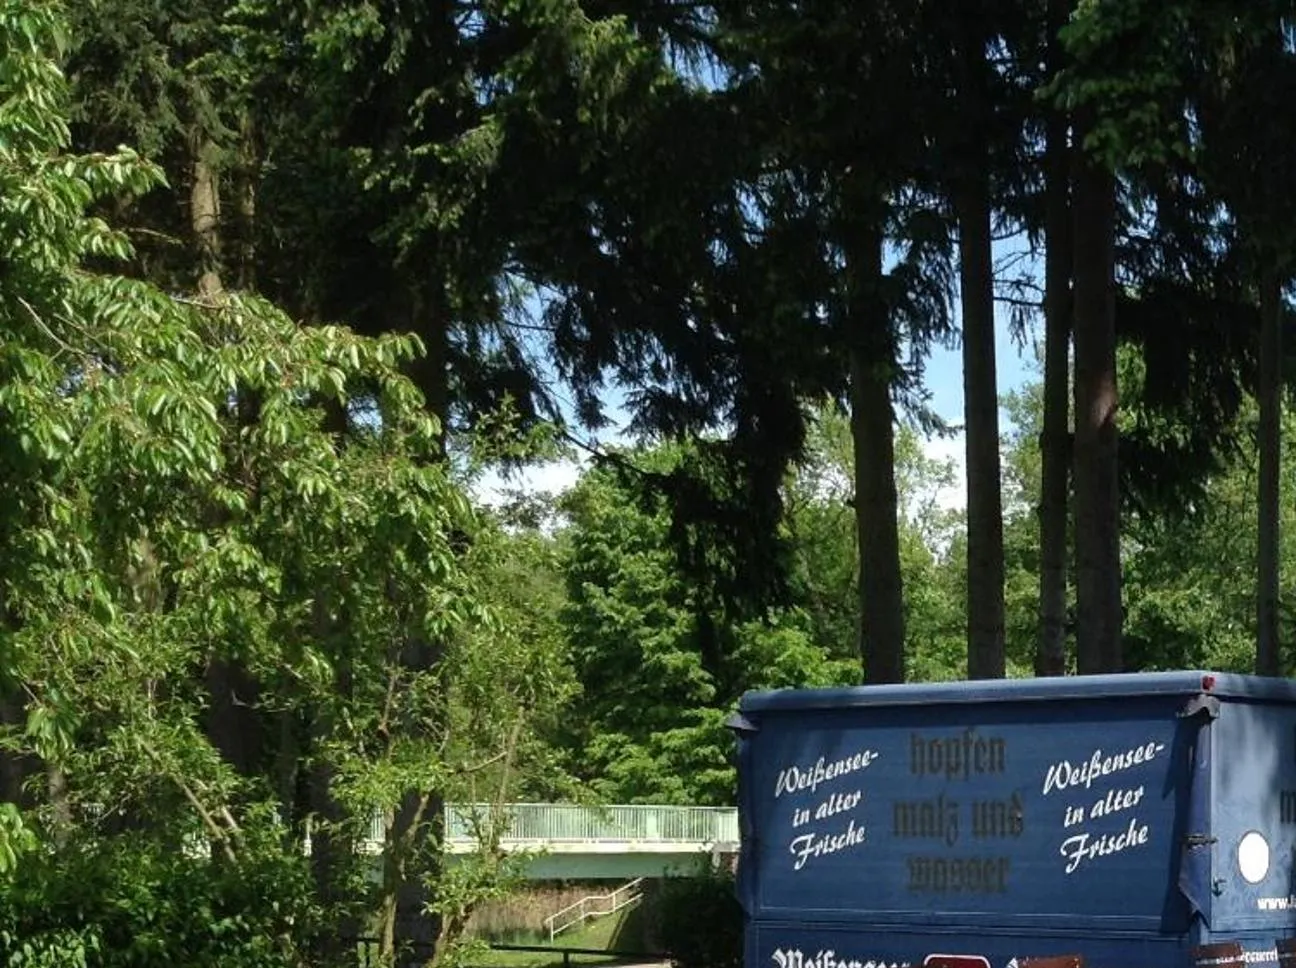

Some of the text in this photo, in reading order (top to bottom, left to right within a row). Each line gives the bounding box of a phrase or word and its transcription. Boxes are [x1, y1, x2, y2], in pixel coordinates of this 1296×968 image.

[775, 748, 879, 798] Weißensee-
[1043, 741, 1165, 796] Weißensee-
[791, 788, 862, 828] in alter
[1063, 784, 1145, 828] in alter
[789, 820, 866, 871] Frische
[1059, 818, 1149, 874] Frische
